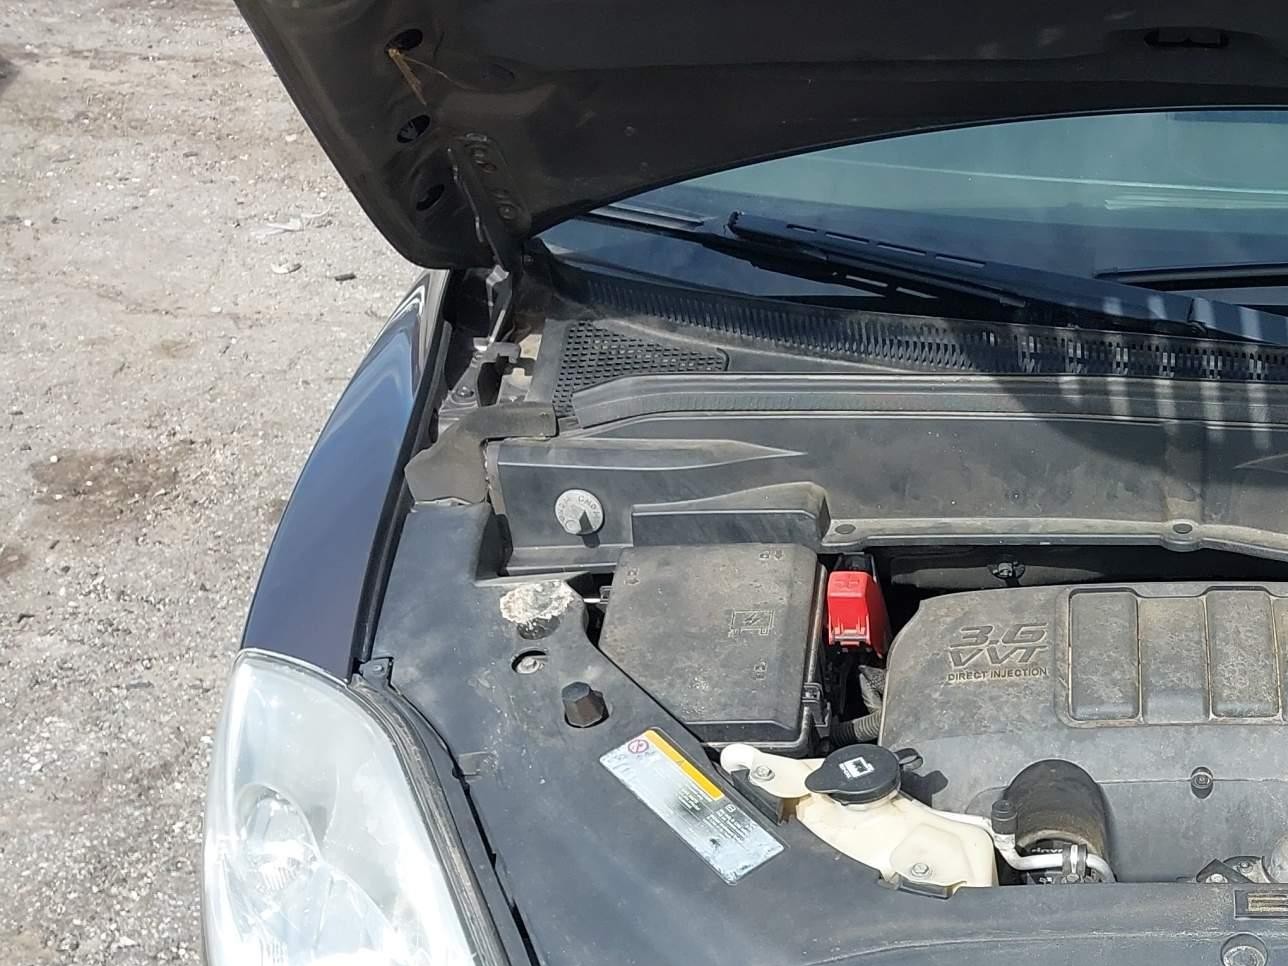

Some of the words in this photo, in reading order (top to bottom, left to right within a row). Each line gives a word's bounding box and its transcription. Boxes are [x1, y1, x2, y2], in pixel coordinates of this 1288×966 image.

[948, 623, 1049, 648] 3.6
[947, 645, 1049, 668] VVT
[947, 670, 988, 682] DIRECT
[989, 667, 1048, 680] INJECTION
